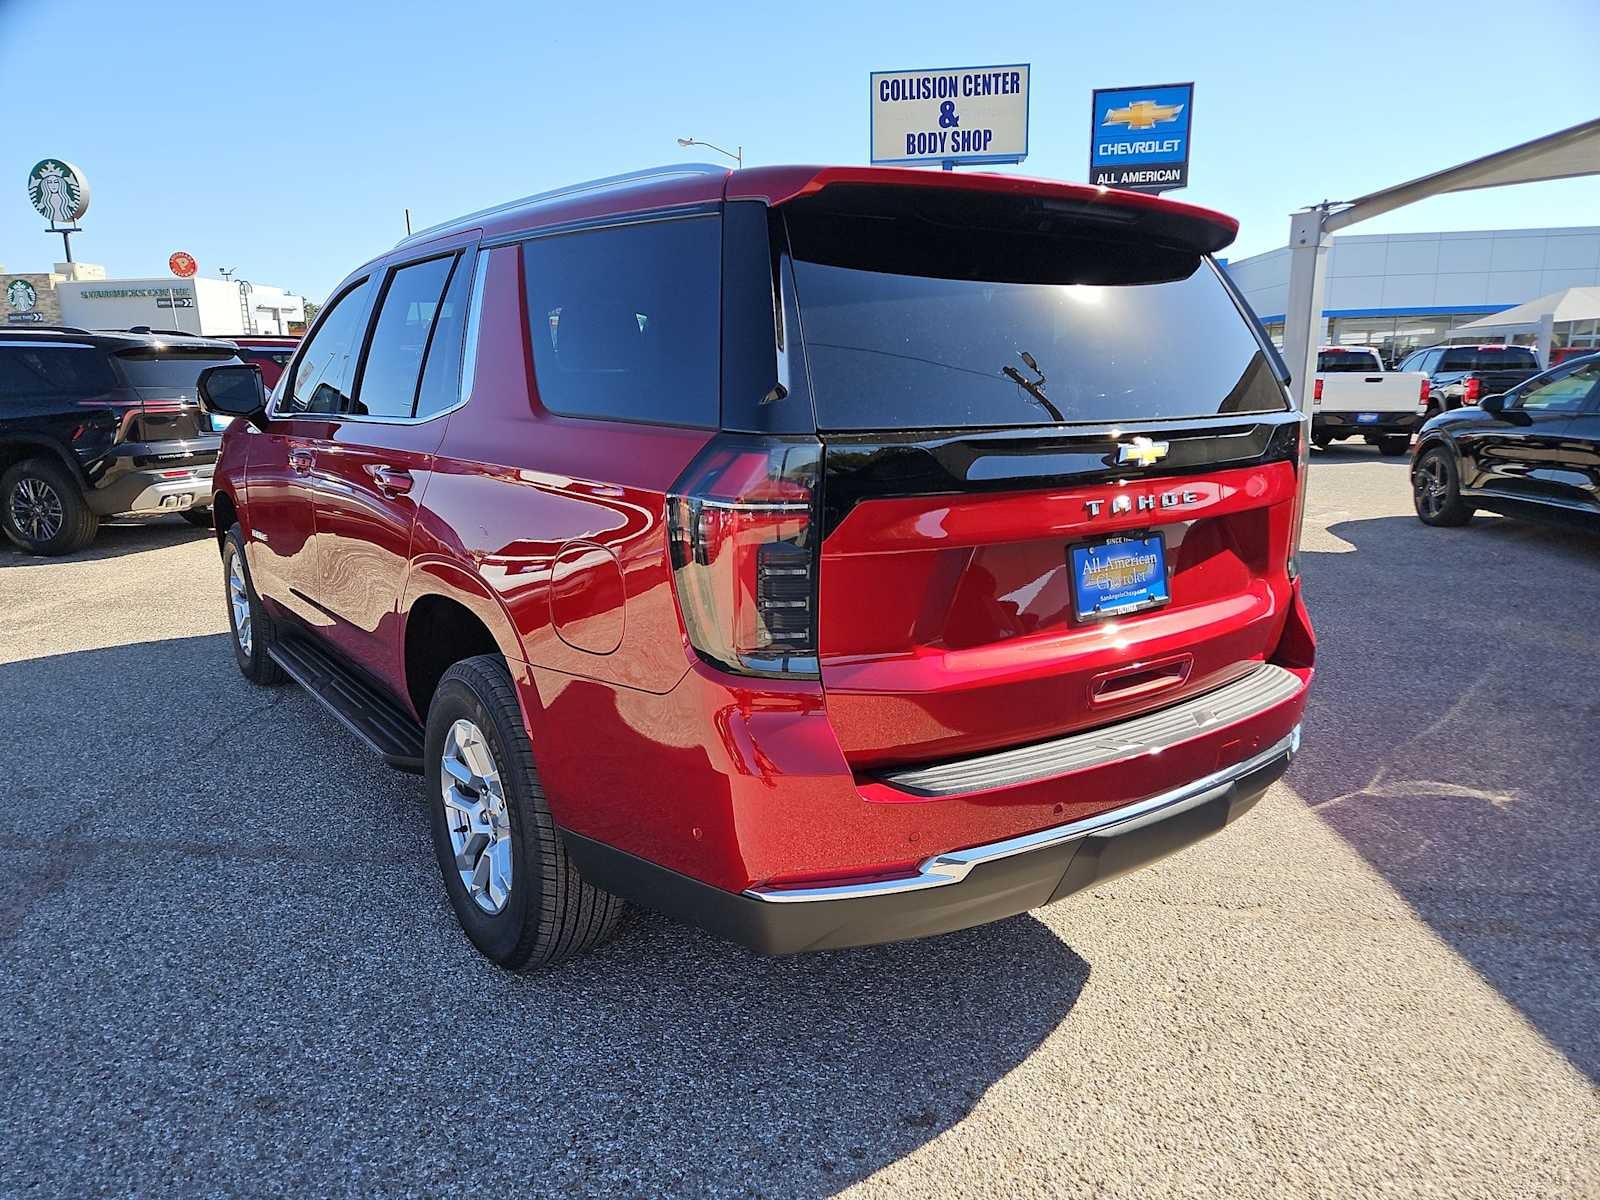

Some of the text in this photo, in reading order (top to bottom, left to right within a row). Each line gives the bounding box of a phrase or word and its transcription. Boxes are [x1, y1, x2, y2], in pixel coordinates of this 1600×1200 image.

[879, 71, 1020, 102] COLLISION CENTER
[938, 101, 960, 129] &
[906, 129, 993, 155] BODY SHOP
[1098, 139, 1182, 157] CHEVROLET
[1096, 169, 1181, 185] ALL AMERICAN
[1085, 491, 1199, 516] TAHOE
[1082, 552, 1157, 575] All American
